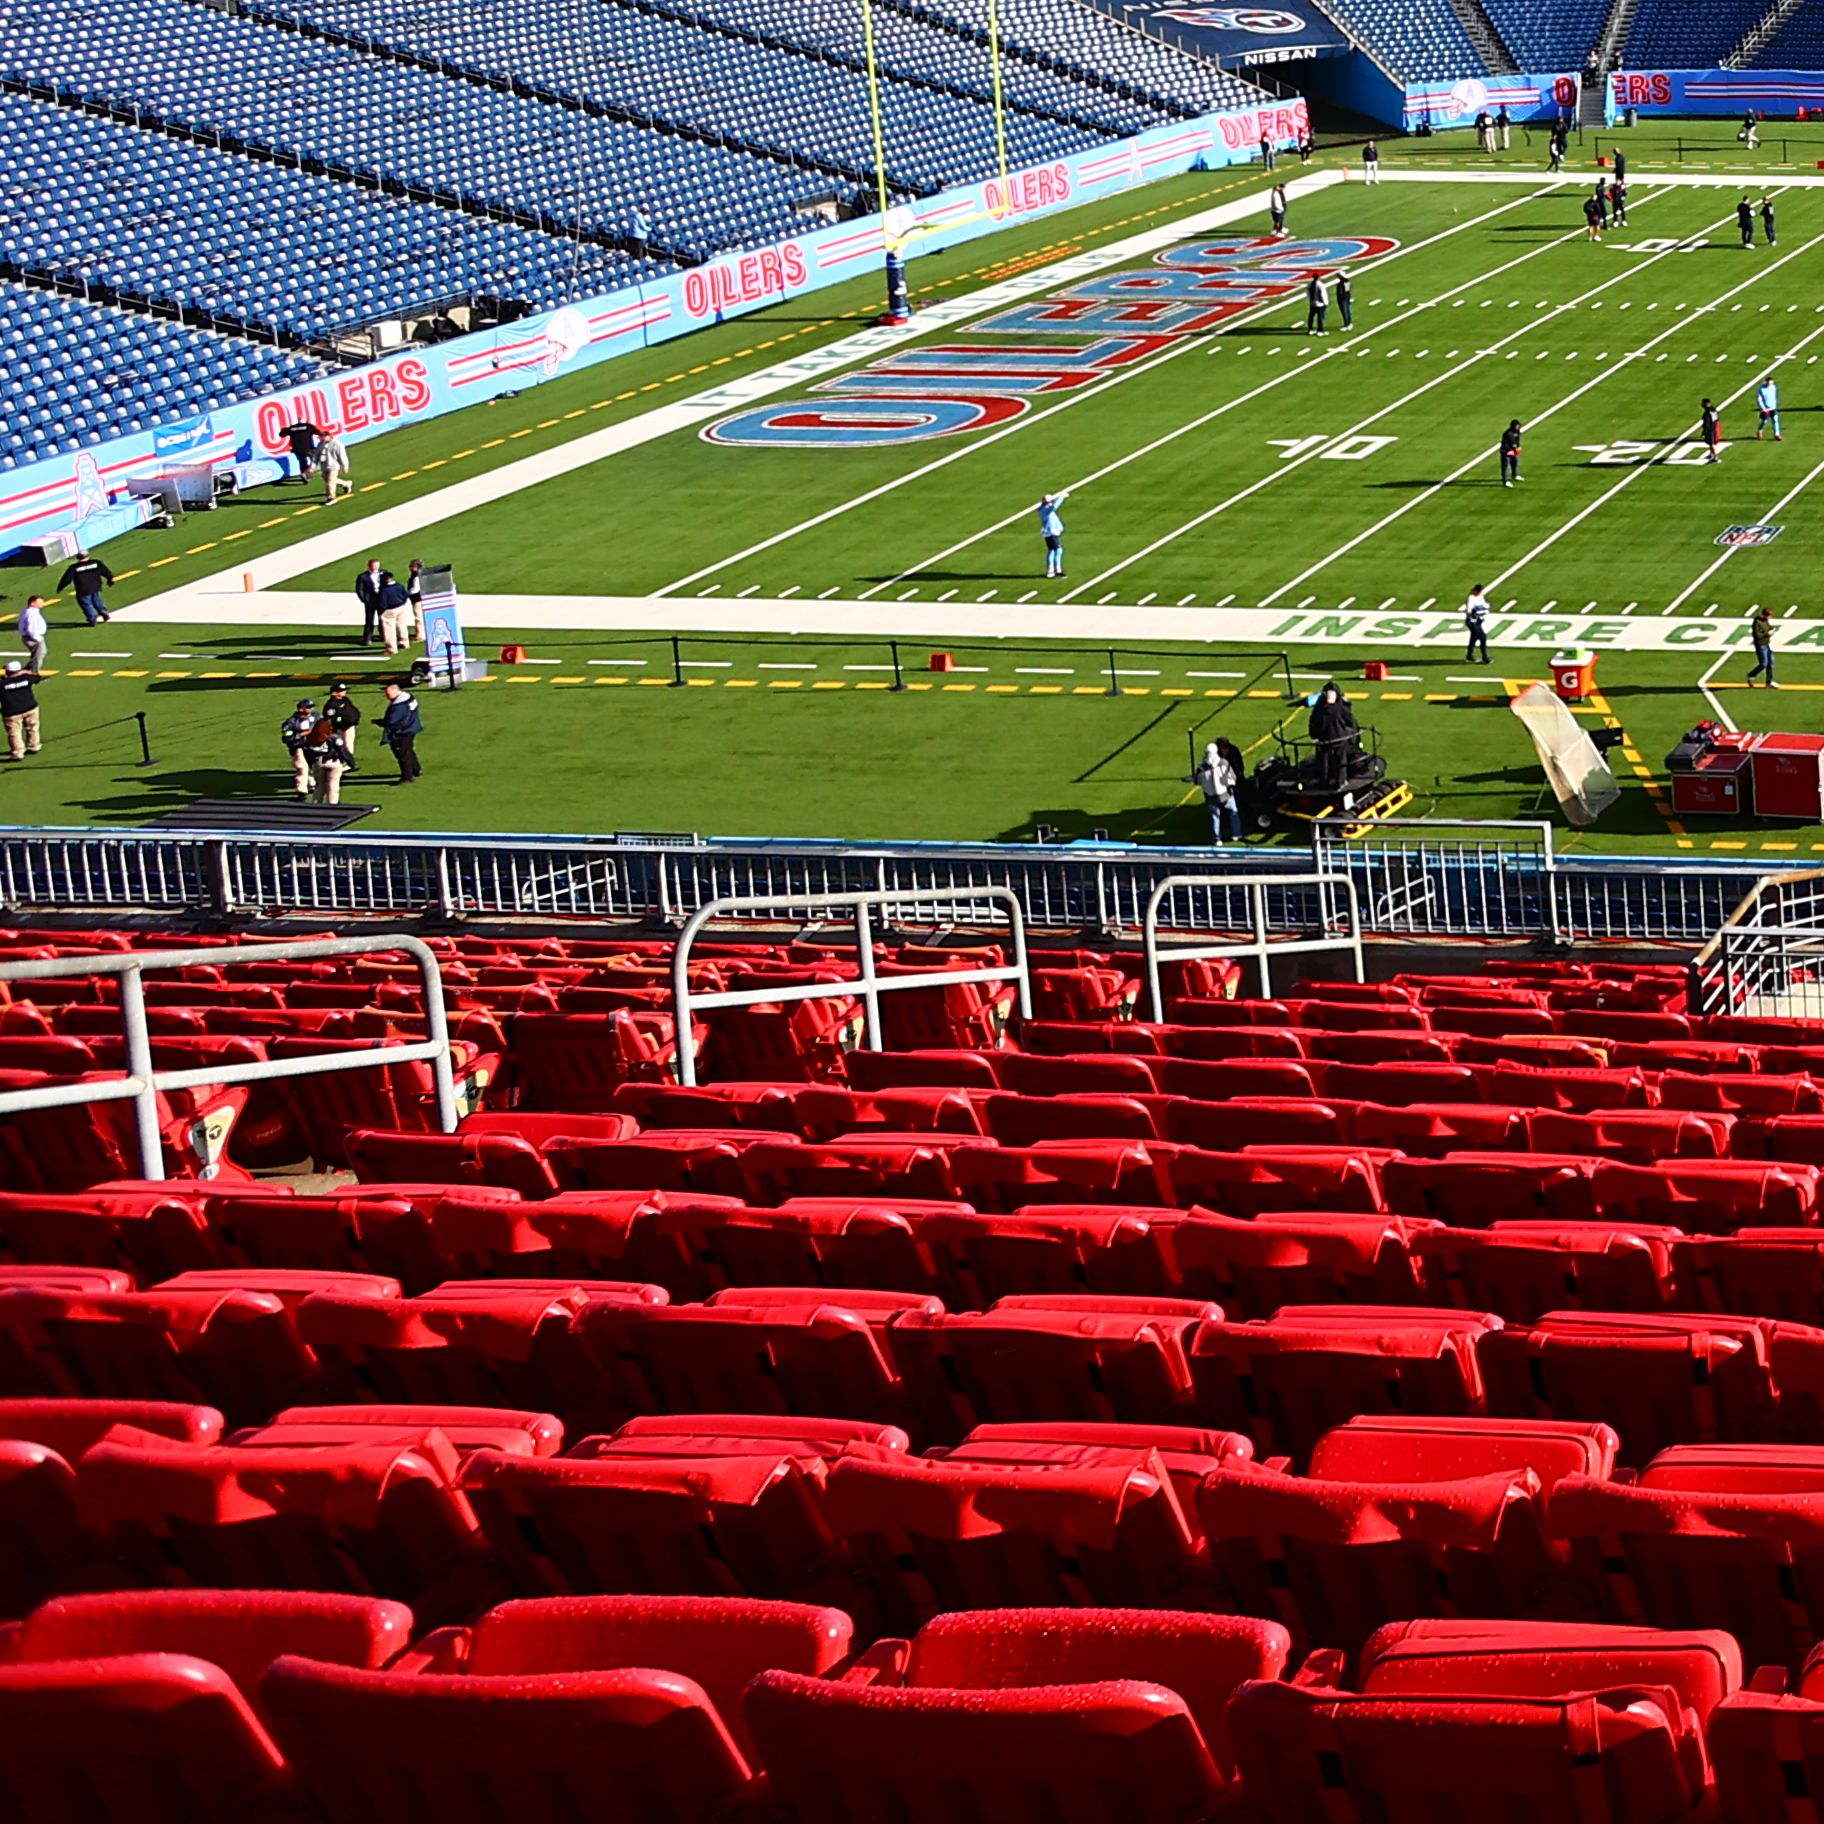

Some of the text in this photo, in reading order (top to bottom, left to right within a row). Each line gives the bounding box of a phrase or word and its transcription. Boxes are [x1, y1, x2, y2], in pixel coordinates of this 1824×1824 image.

[1245, 48, 1317, 66] NISSAN
[1219, 100, 1310, 148] OILERS
[685, 243, 807, 318] OILERS
[698, 234, 1402, 449] OILERS
[257, 358, 432, 457] OILERS
[1279, 435, 1397, 460] 10
[1593, 440, 1729, 465] 20
[1267, 614, 1631, 644] INSPIRE
[1561, 671, 1578, 689] G
